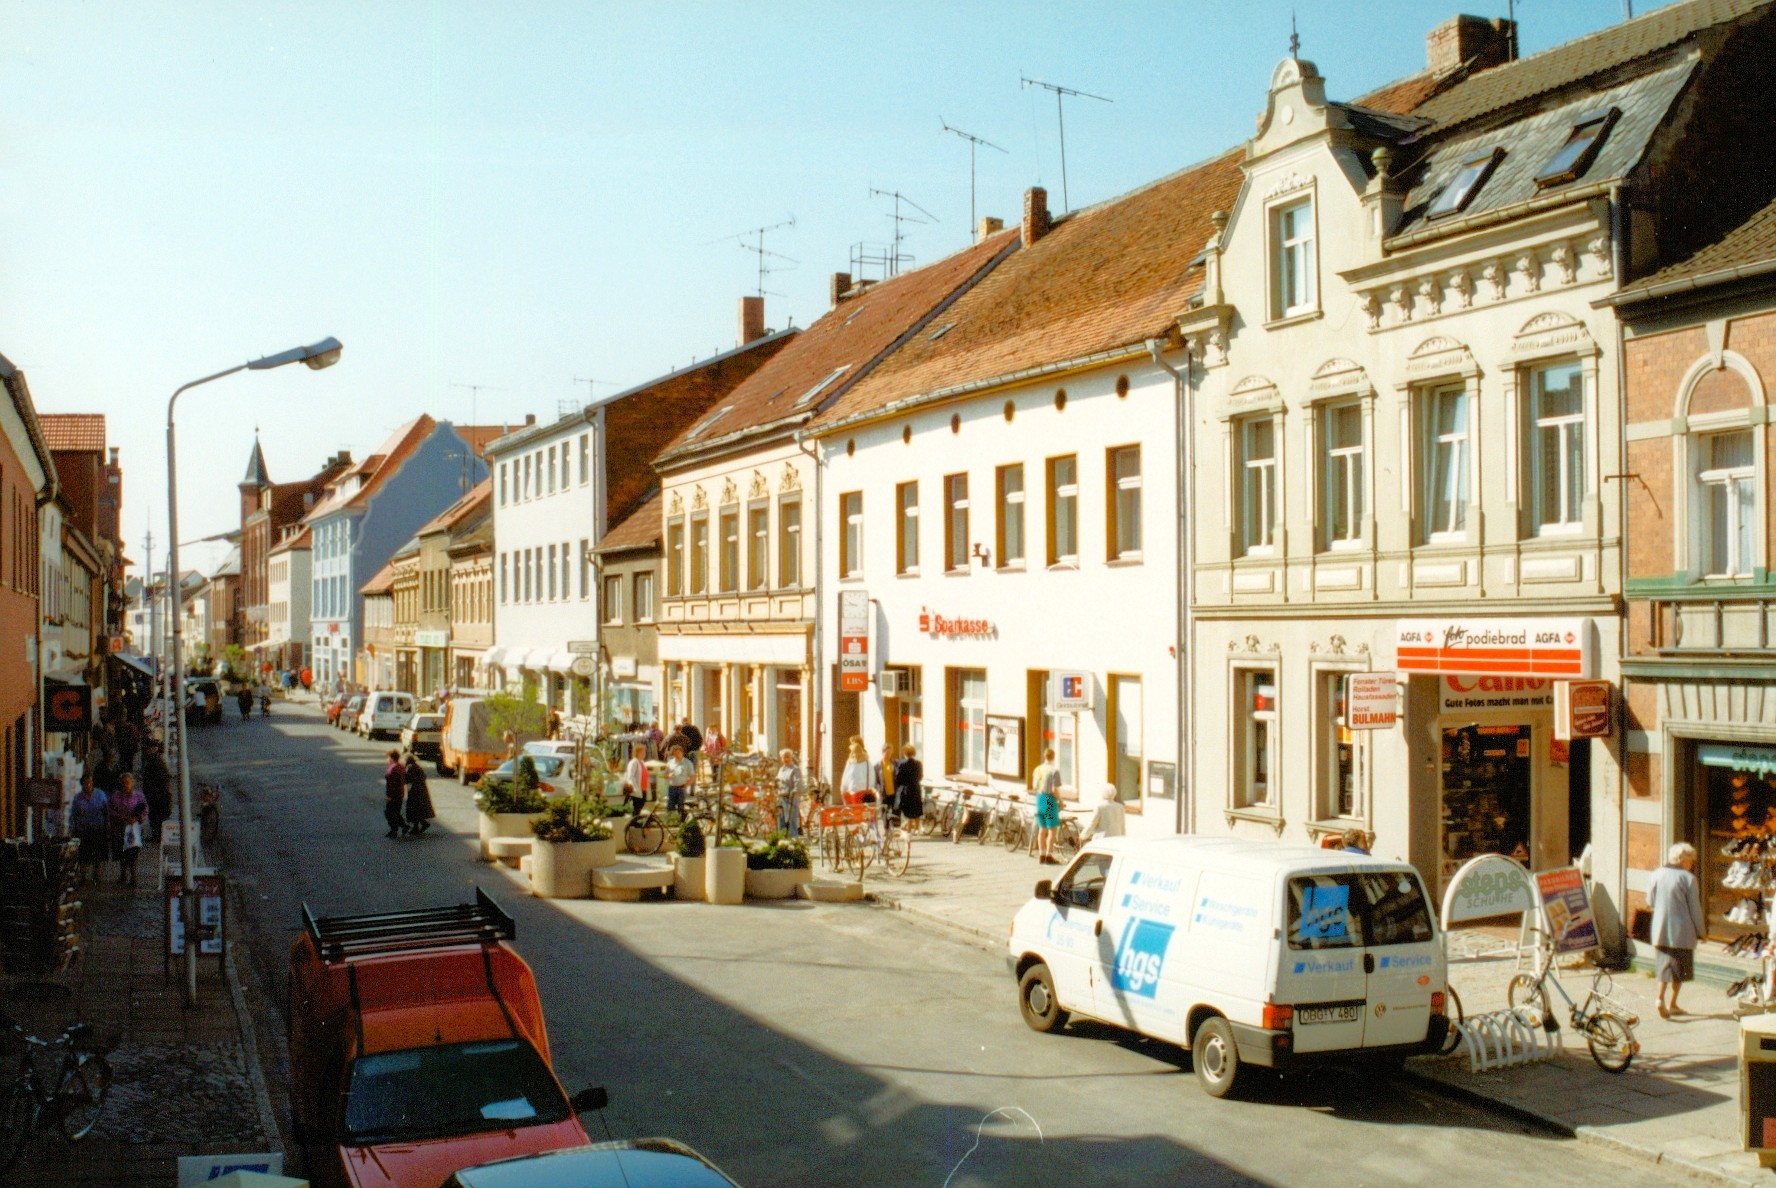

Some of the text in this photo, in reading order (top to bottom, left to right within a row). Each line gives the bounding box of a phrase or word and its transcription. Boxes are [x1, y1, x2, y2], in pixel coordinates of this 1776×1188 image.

[934, 615, 989, 634] Sparkasse
[1400, 632, 1421, 643] AGFA
[1466, 629, 1526, 648] podiebrad
[1535, 633, 1560, 644] AGFA
[846, 677, 863, 685] LBS
[1445, 698, 1463, 708] Gute
[1465, 698, 1485, 707] Fotos
[1487, 697, 1510, 707] macht
[1512, 697, 1529, 706] man
[1531, 696, 1544, 705] mit
[1353, 712, 1396, 725] BULMAHN
[1141, 872, 1181, 892] Verkauf
[1132, 895, 1171, 916] Service
[1306, 906, 1344, 932] hgs
[1308, 960, 1354, 973] Verkauf
[1391, 955, 1432, 968] Service
[1118, 947, 1161, 991] hgs
